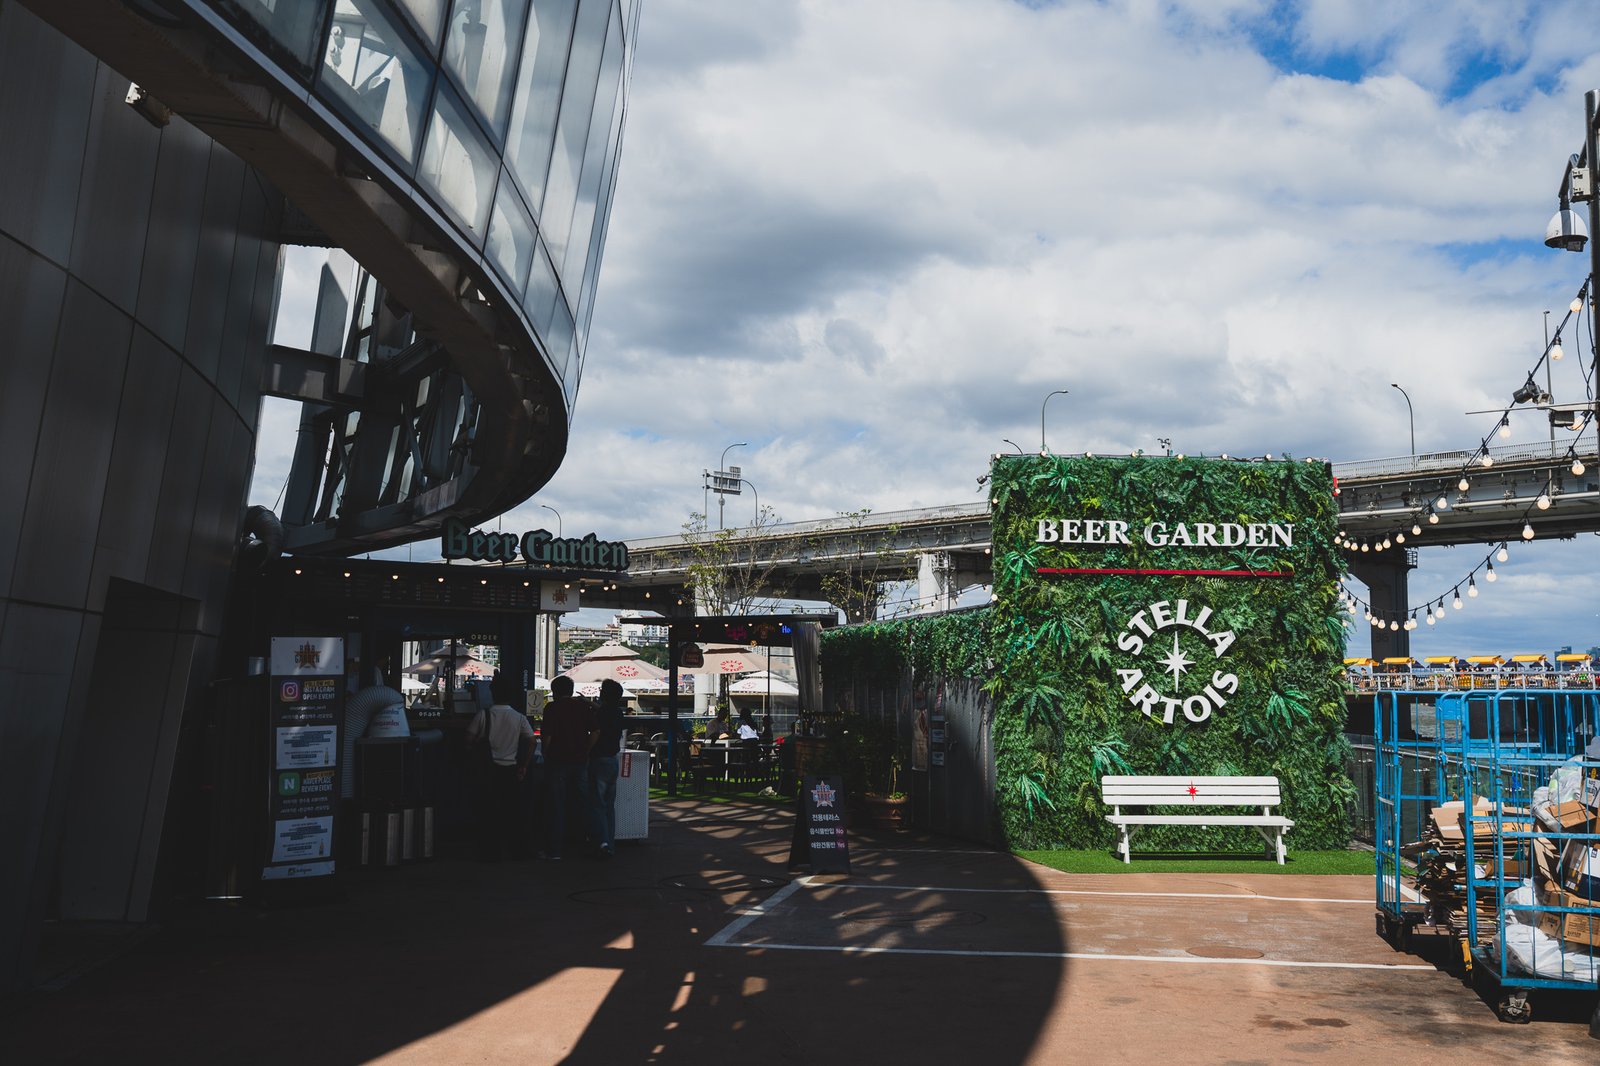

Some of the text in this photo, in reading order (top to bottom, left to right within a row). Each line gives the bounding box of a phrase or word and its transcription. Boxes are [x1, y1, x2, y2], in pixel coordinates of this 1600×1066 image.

[445, 516, 629, 569] Beer Garden
[1035, 518, 1295, 548] BEER GARDEN
[1117, 599, 1237, 658] STELLA
[1116, 666, 1239, 725] ARTOIS
